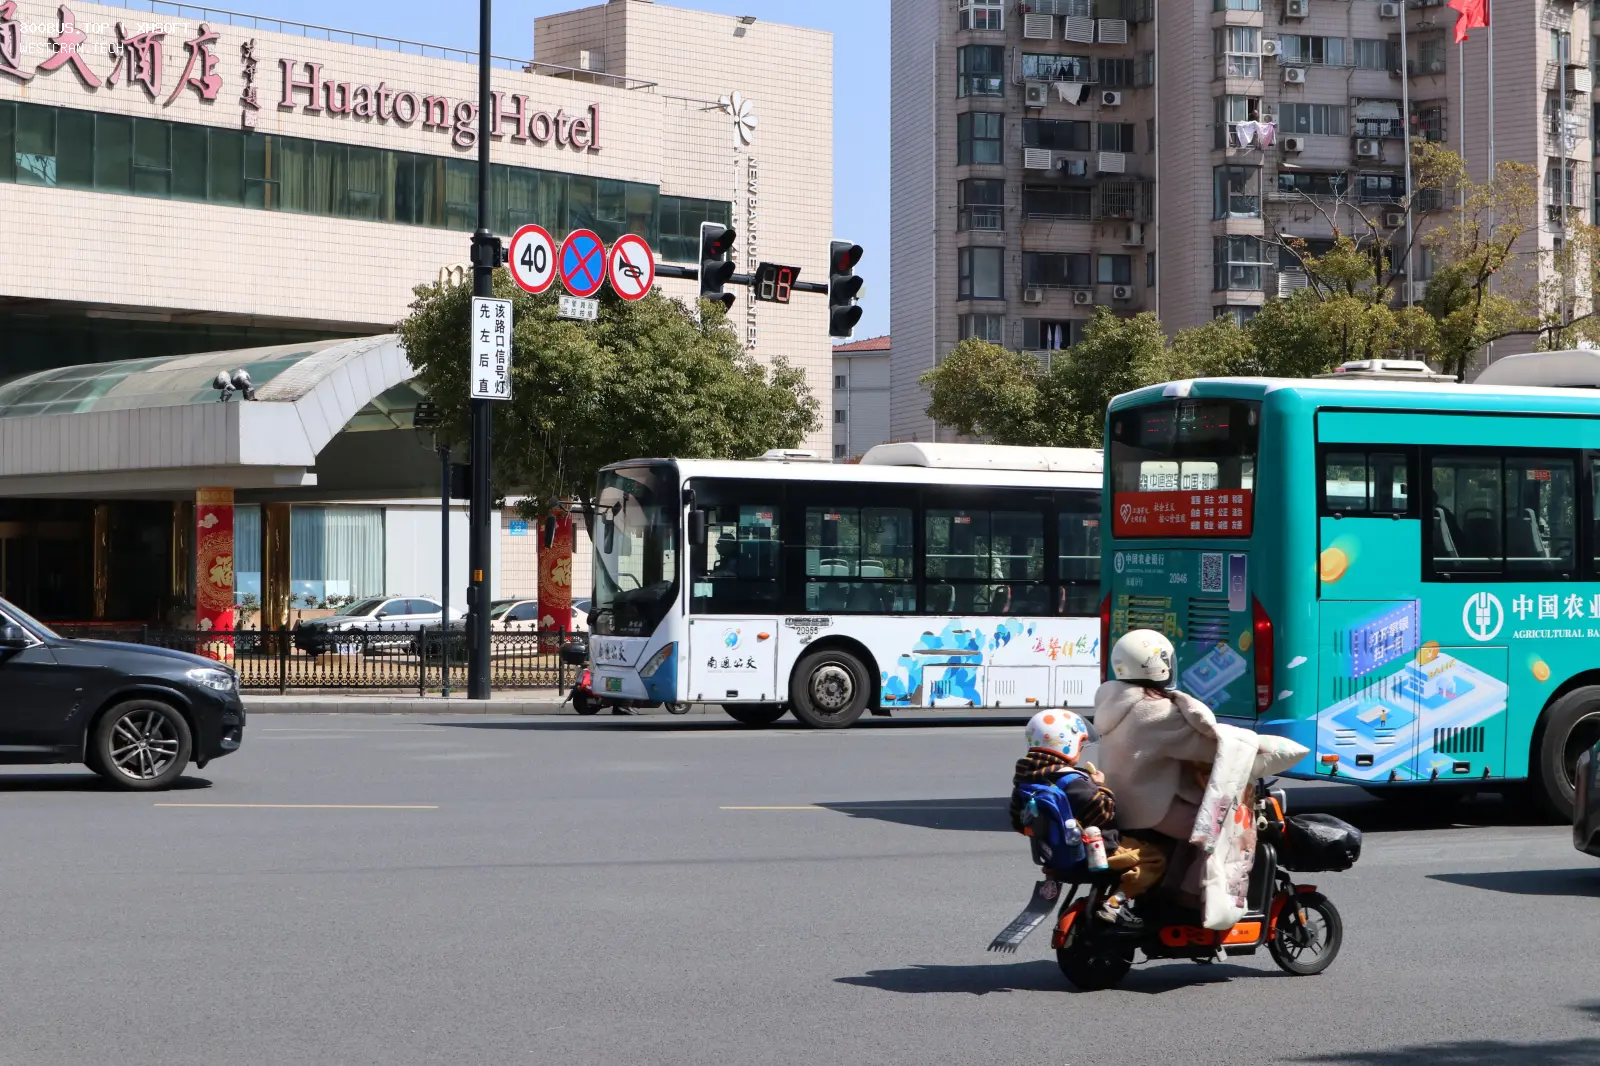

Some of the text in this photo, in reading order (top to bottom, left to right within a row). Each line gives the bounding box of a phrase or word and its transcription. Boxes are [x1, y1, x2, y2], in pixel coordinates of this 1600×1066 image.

[278, 58, 480, 147] Huatong
[490, 90, 602, 150] Hotel
[747, 156, 759, 195] NEW
[520, 243, 547, 274] 40
[746, 284, 758, 349] ENTER
[478, 303, 491, 394] 先左后直
[494, 303, 506, 395] 该路口信号灯
[208, 555, 234, 588] 福
[1125, 552, 1165, 566] 中国农业银行
[1512, 628, 1585, 639] AGRICULTURAL
[707, 655, 758, 669] 南通公交
[1427, 658, 1457, 679] BANK
